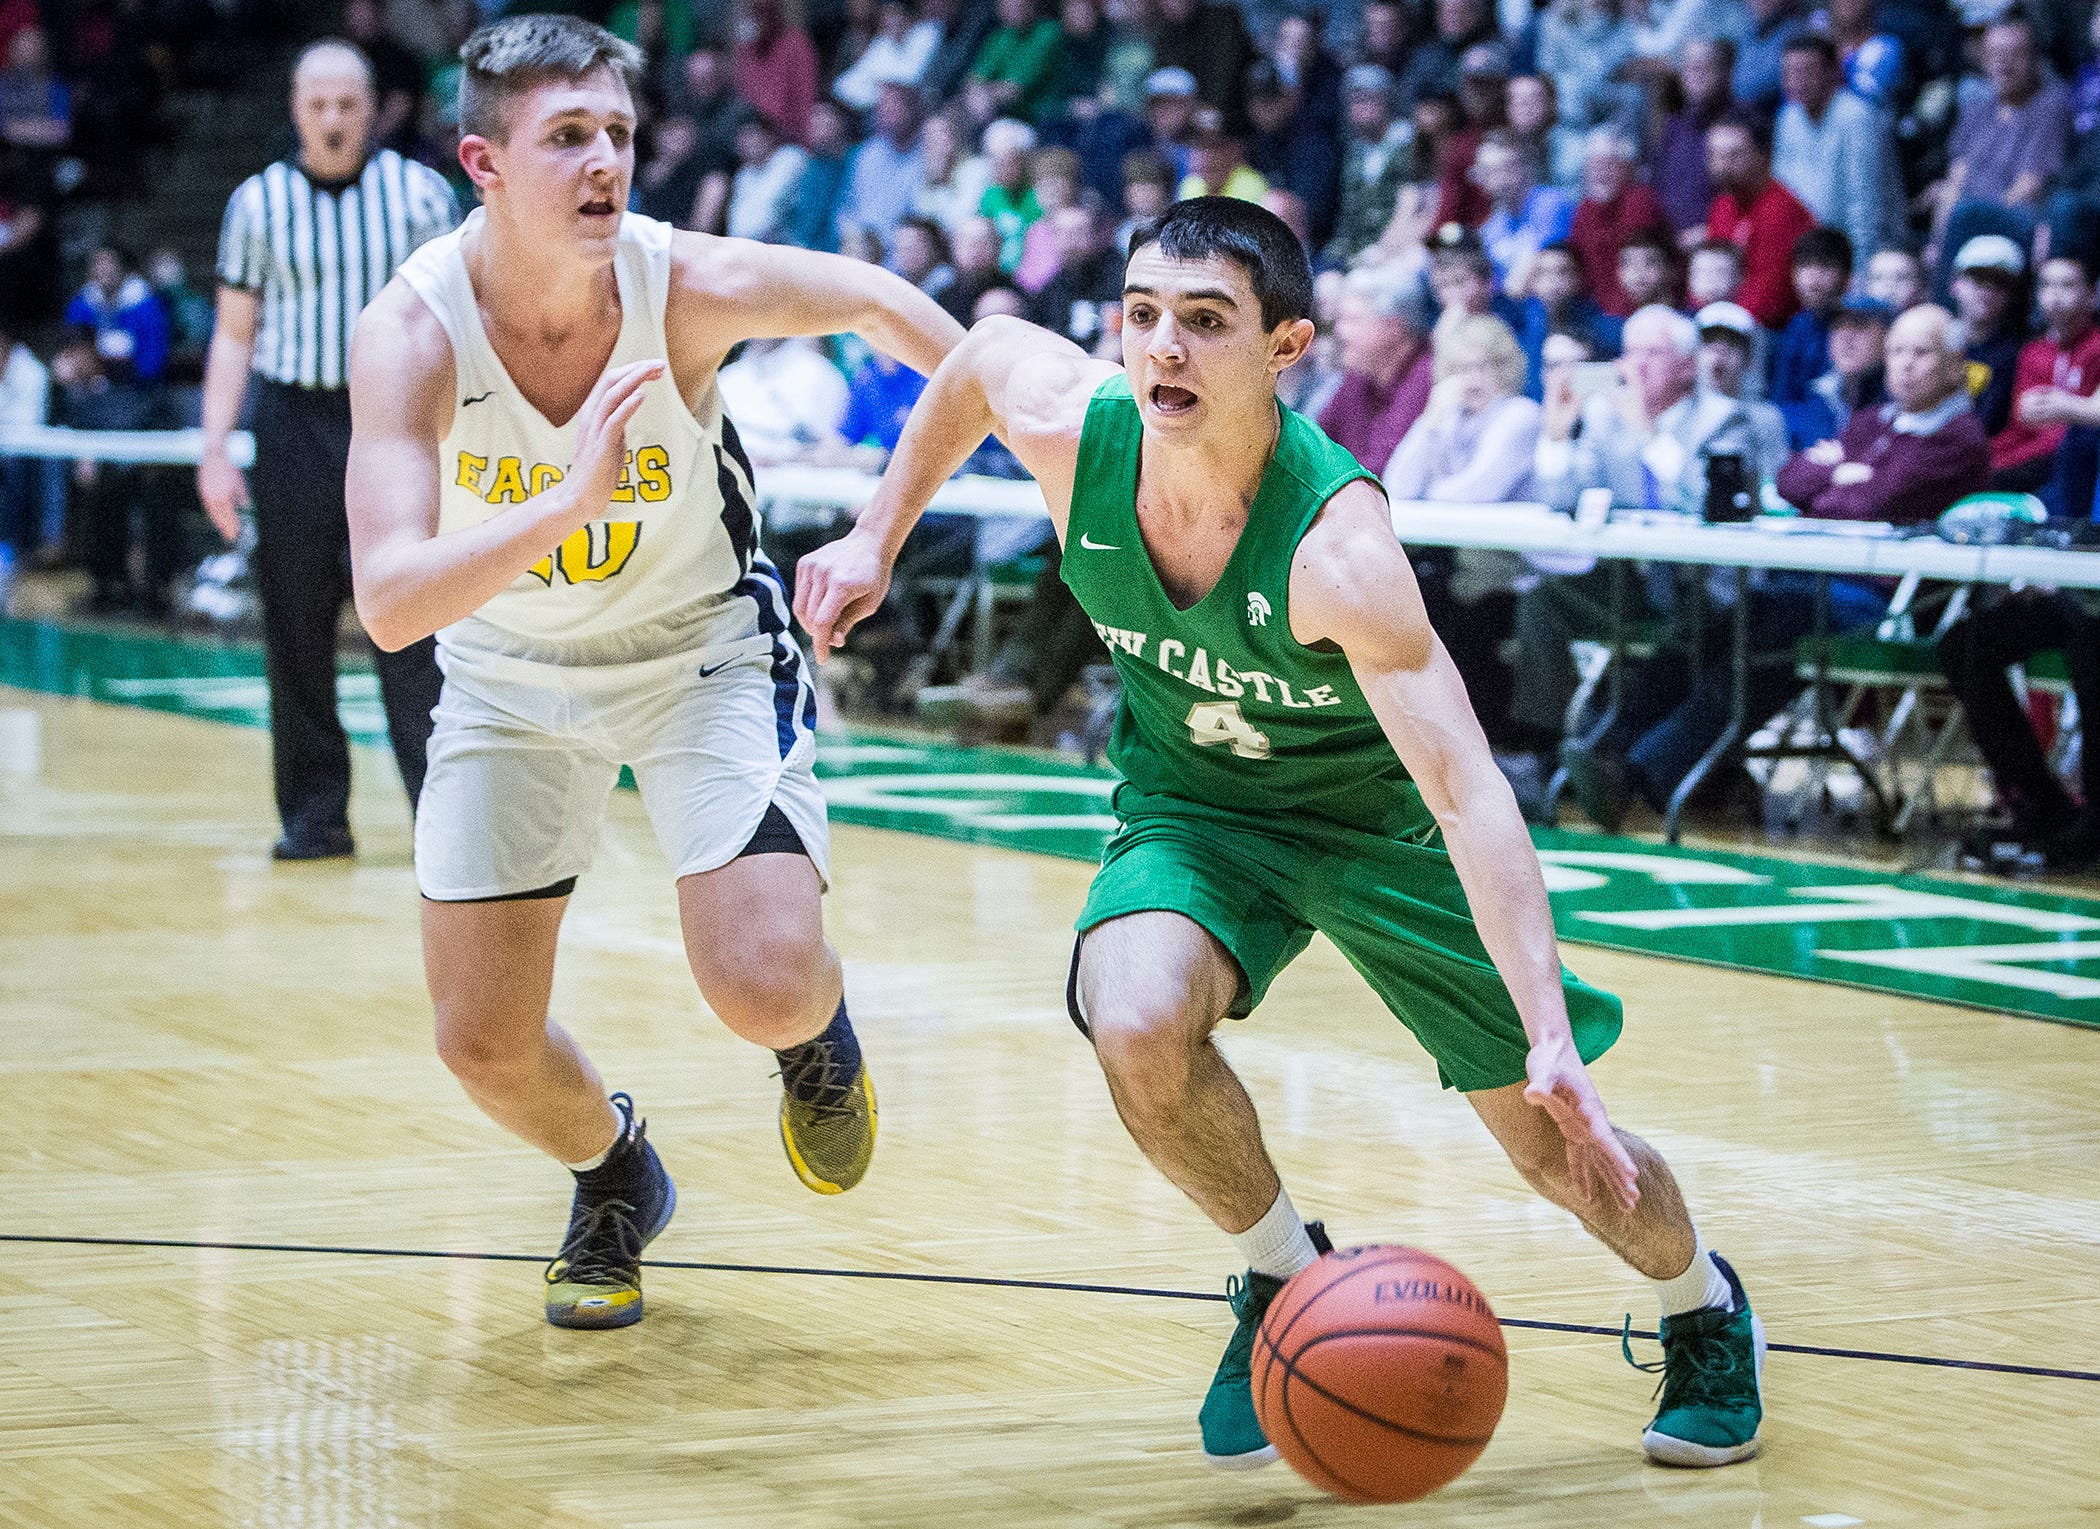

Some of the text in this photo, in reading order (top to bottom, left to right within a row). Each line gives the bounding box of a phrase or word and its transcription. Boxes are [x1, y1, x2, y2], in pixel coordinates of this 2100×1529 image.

[455, 444, 672, 504] EAGES
[1158, 638, 1342, 708] CASTLE
[1184, 700, 1270, 760] 4
